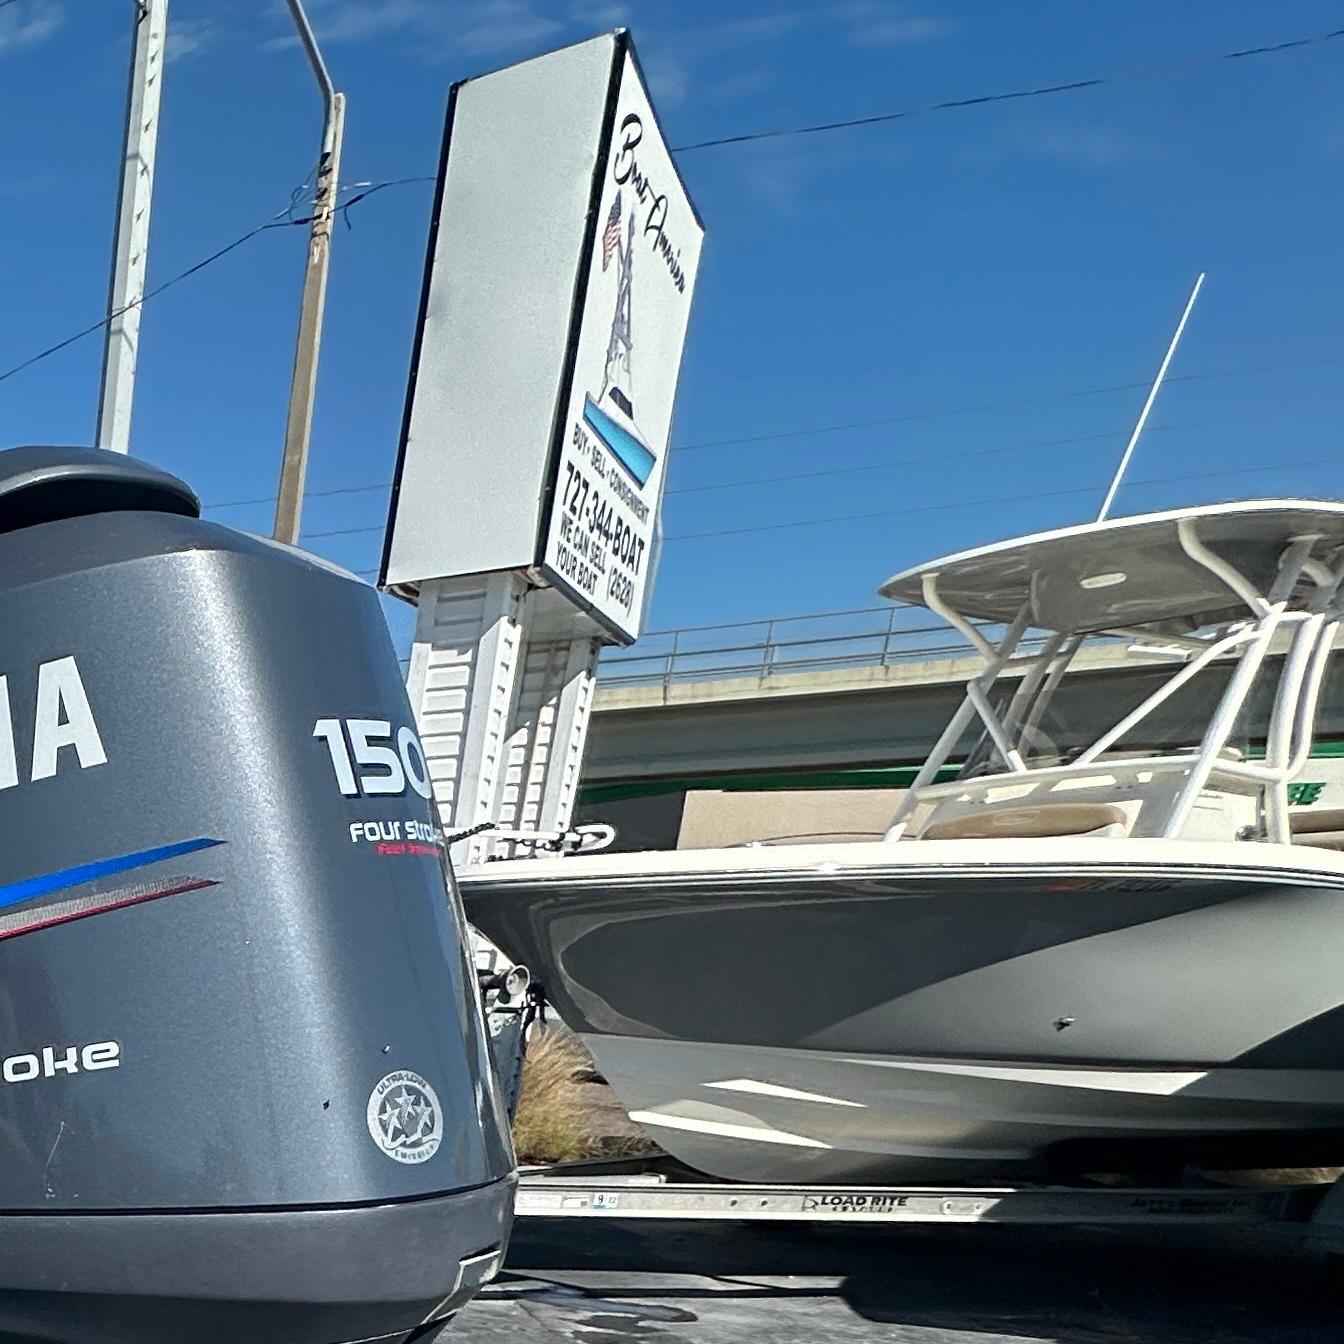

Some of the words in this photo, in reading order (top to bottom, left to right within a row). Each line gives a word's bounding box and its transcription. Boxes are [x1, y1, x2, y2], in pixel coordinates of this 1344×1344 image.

[573, 422, 588, 456] BUY
[591, 445, 607, 480] SELL
[609, 467, 650, 526] CONSIGNMENT
[561, 510, 574, 544] WE
[573, 524, 590, 560] CAN
[589, 540, 606, 575] SELL
[563, 459, 645, 577] 727-344-BOAT
[556, 540, 577, 582] YOUR
[577, 561, 598, 596] BOAT
[606, 564, 635, 618] (2628)
[313, 718, 433, 800] 150
[821, 1196, 867, 1206] LOAD
[870, 1197, 909, 1207] RITE
